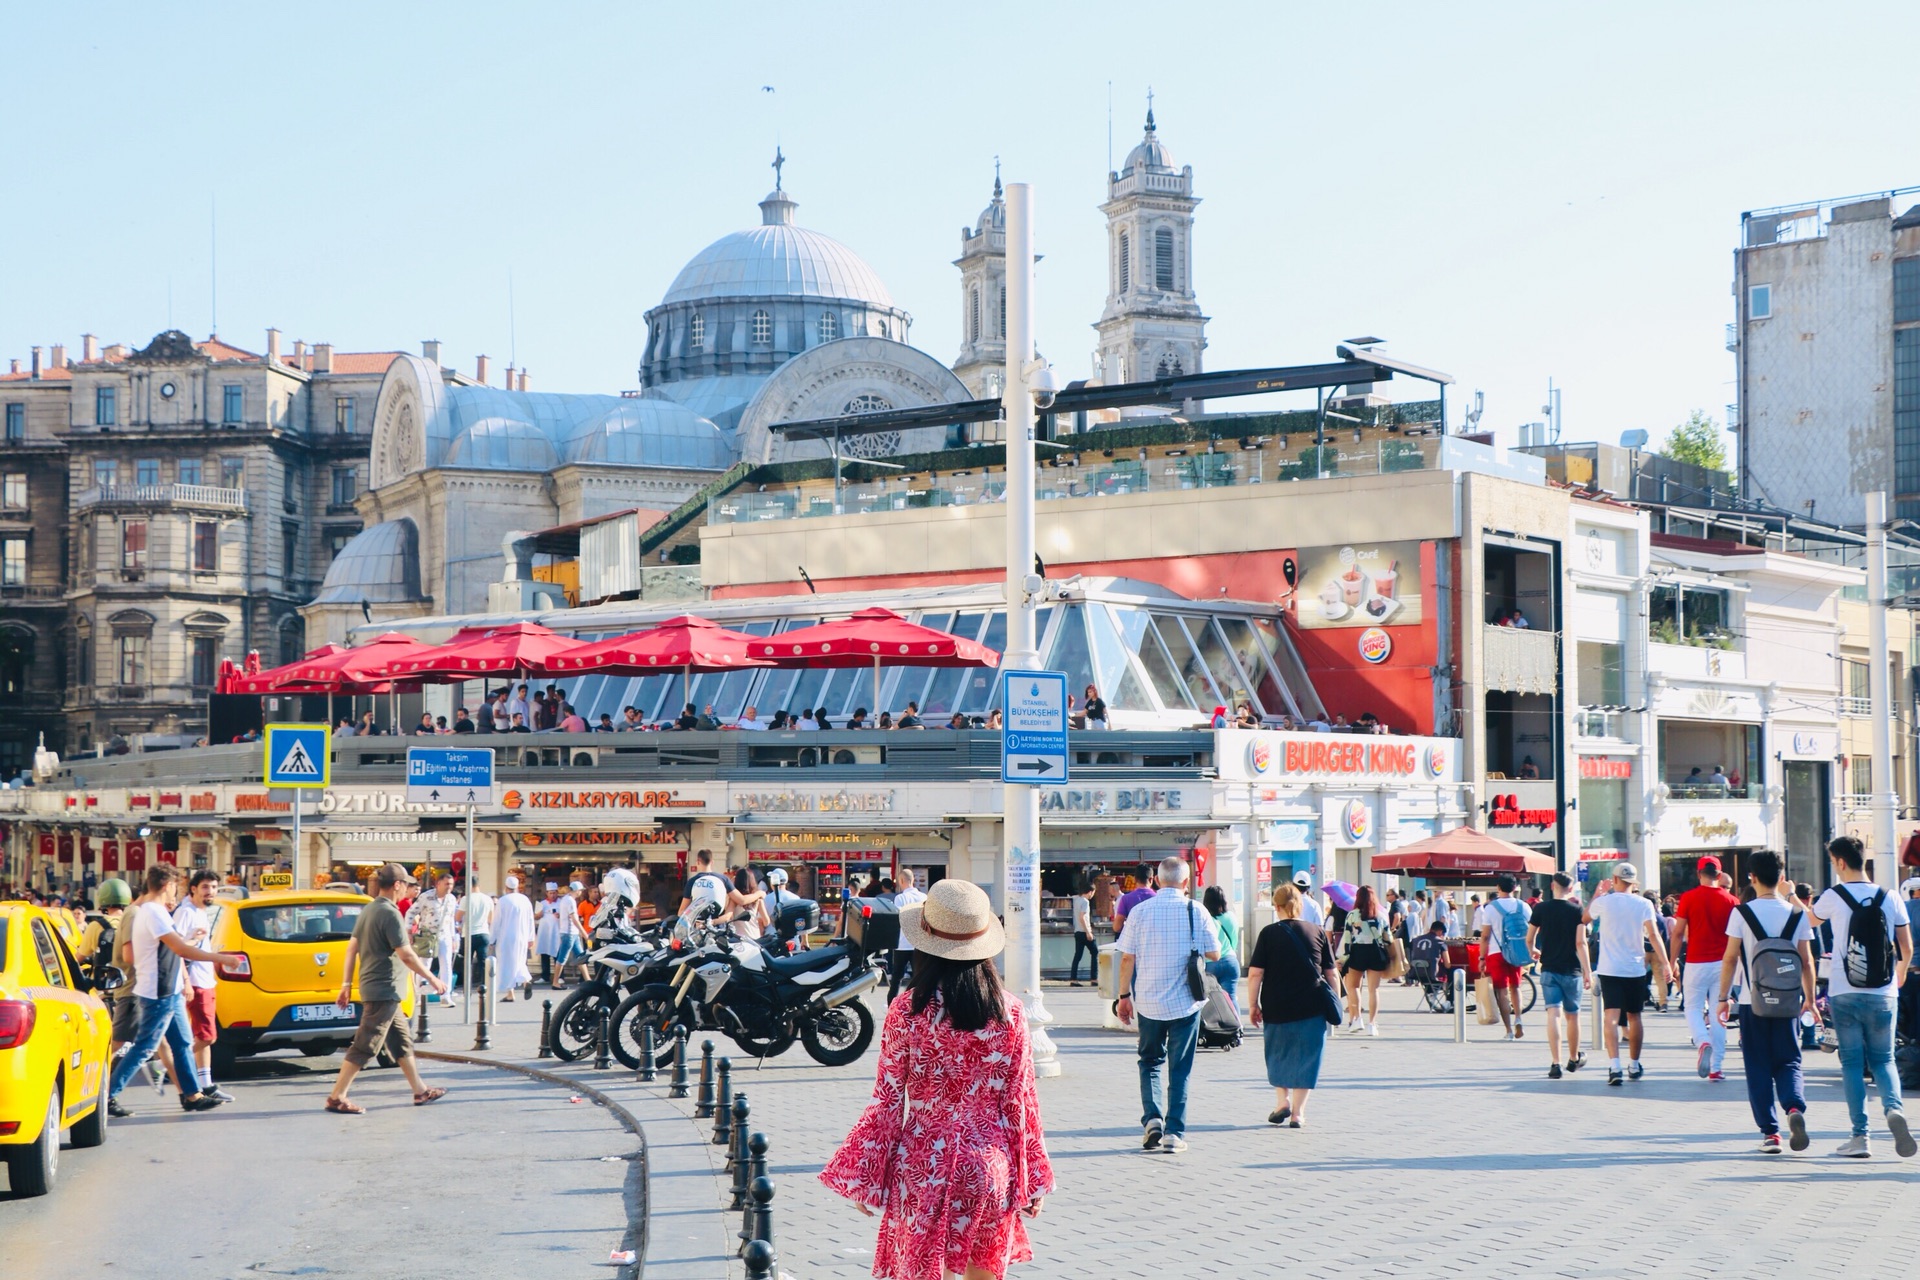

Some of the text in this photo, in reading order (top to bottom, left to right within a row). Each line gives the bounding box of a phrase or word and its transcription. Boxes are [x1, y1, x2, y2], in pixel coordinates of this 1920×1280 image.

[1357, 549, 1378, 560] CAFÉ
[1362, 635, 1385, 646] BURGER
[1362, 642, 1386, 653] KING
[1012, 708, 1060, 716] BÜYÜKŞEHİR
[446, 753, 468, 762] Taksim
[1285, 741, 1416, 774] BURGER KING
[426, 764, 448, 774] Eğitim
[458, 764, 489, 774] Araştırma
[442, 775, 472, 784] Hastanesi
[529, 790, 670, 808] KIZILKAYALAR
[734, 790, 892, 812] TAKSİM DÖNER
[1116, 788, 1182, 811] BÜFE
[1494, 806, 1522, 825] simit
[1847, 936, 1868, 986] NIKE
[298, 1008, 309, 1017] 34
[315, 1006, 332, 1016] TJS
